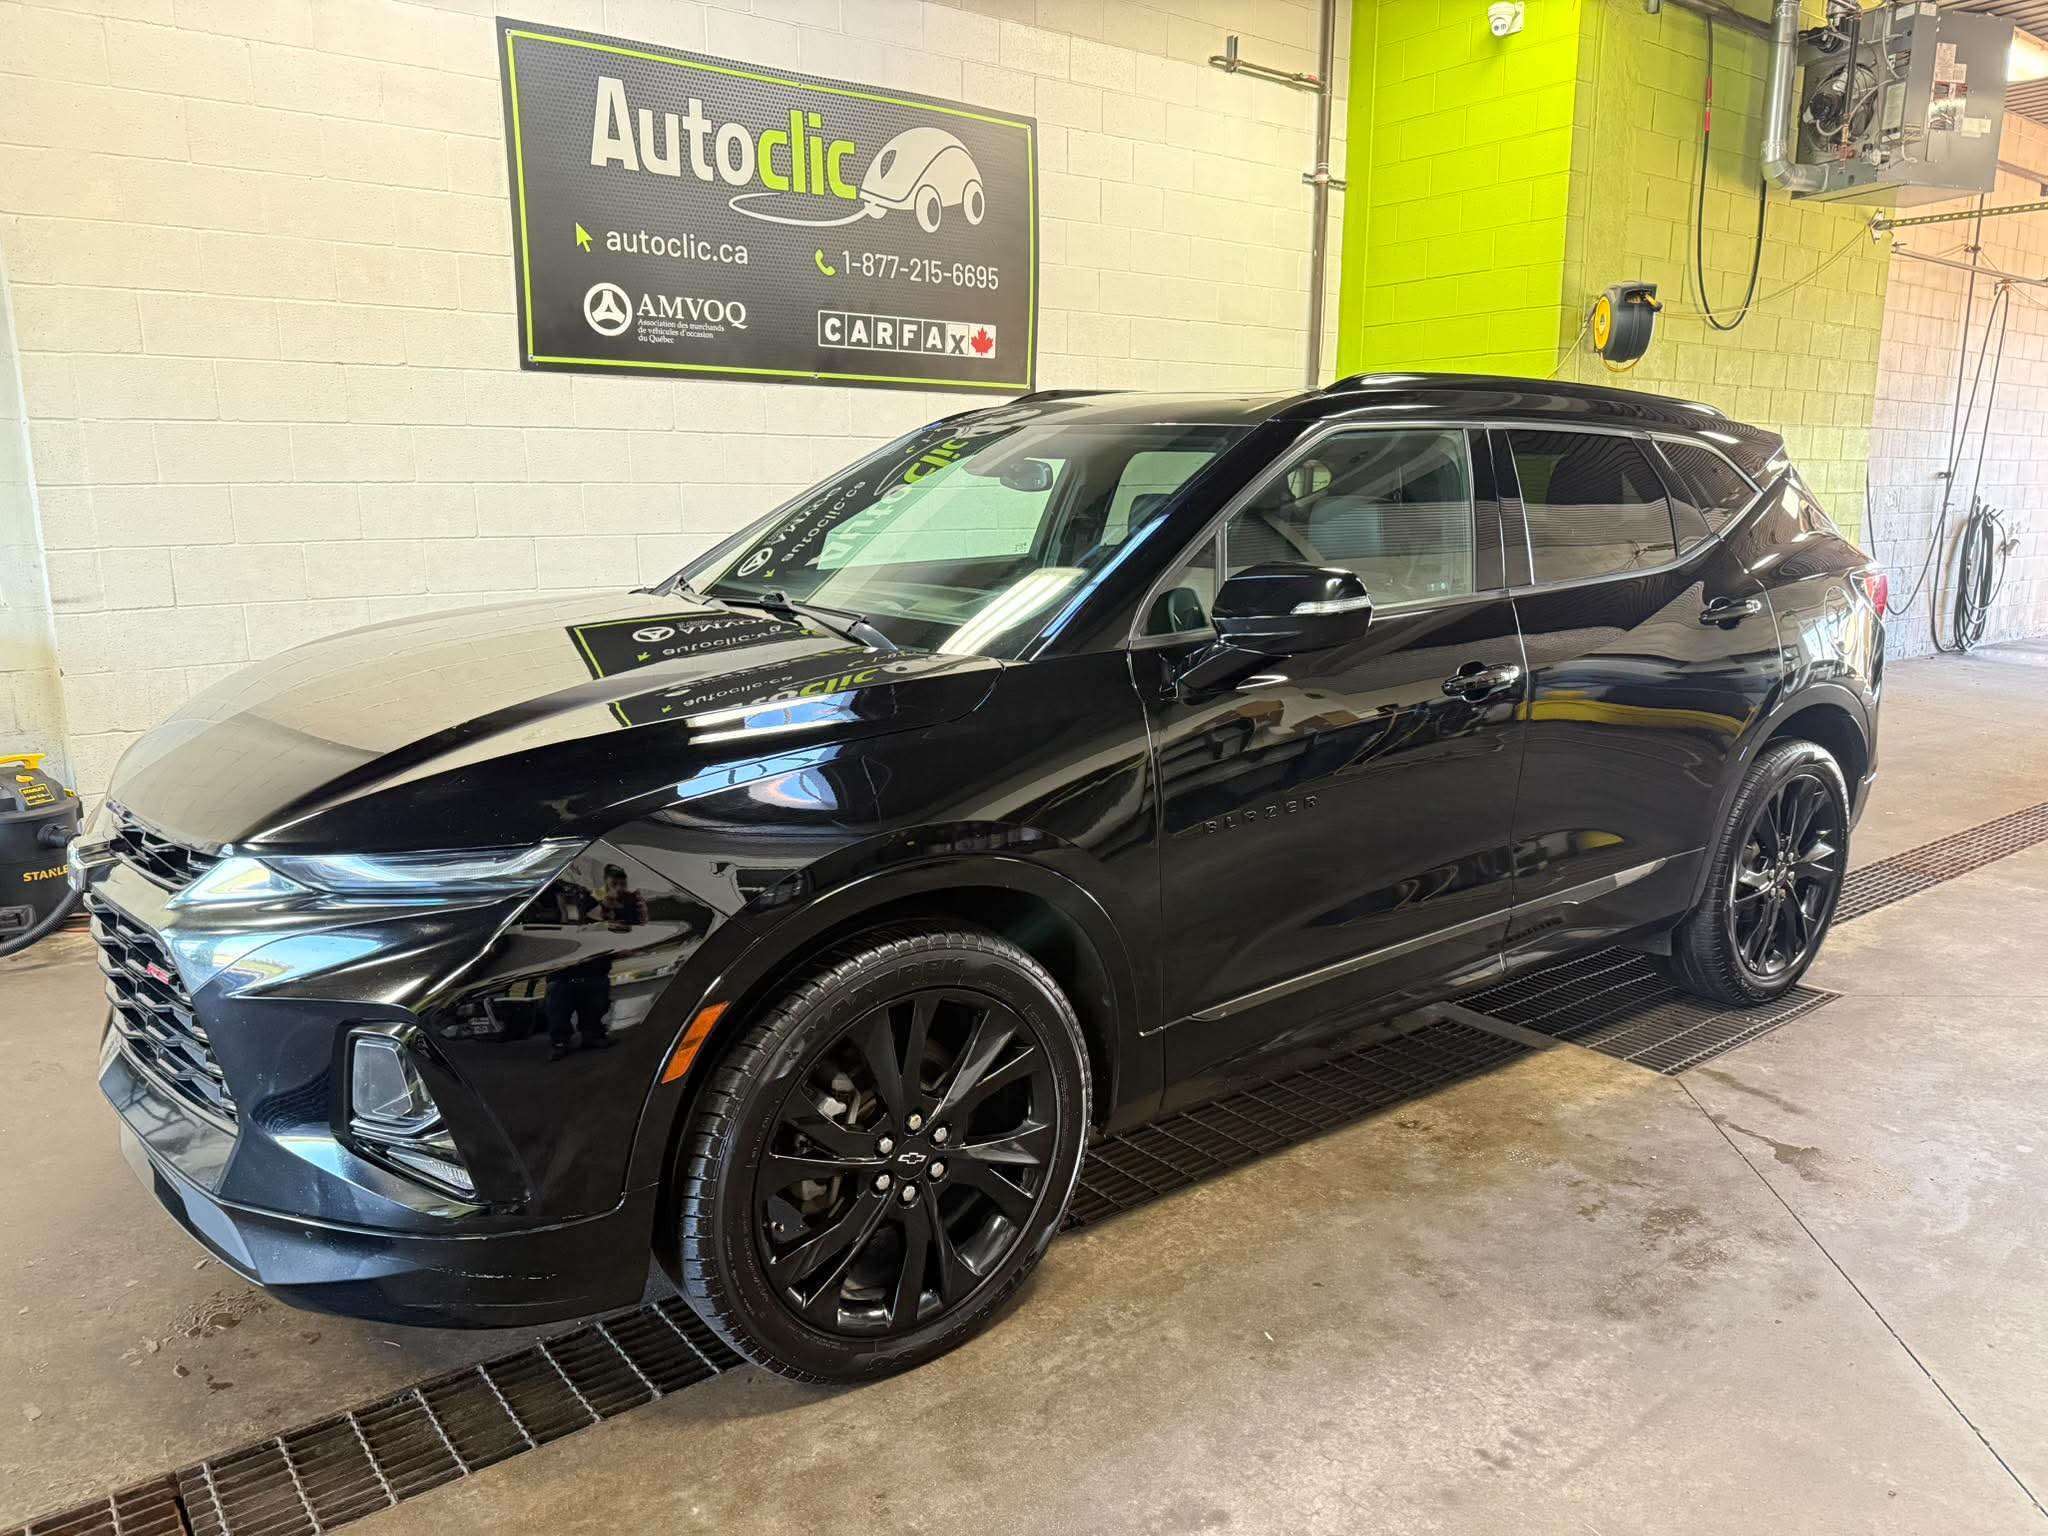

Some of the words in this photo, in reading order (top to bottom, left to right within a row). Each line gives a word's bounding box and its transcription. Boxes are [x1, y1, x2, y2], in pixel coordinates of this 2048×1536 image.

[590, 76, 857, 200] Autoclic
[606, 230, 748, 265] autoclic.ca
[842, 250, 999, 290] 1-877-215-6695
[636, 293, 749, 330] AMVOQ
[637, 319, 676, 328] Association
[677, 321, 688, 329] des
[637, 326, 647, 334] de
[638, 334, 648, 342] du
[649, 334, 674, 344] Québec
[824, 317, 967, 355] CARFAX
[23, 864, 69, 882] STANLE
